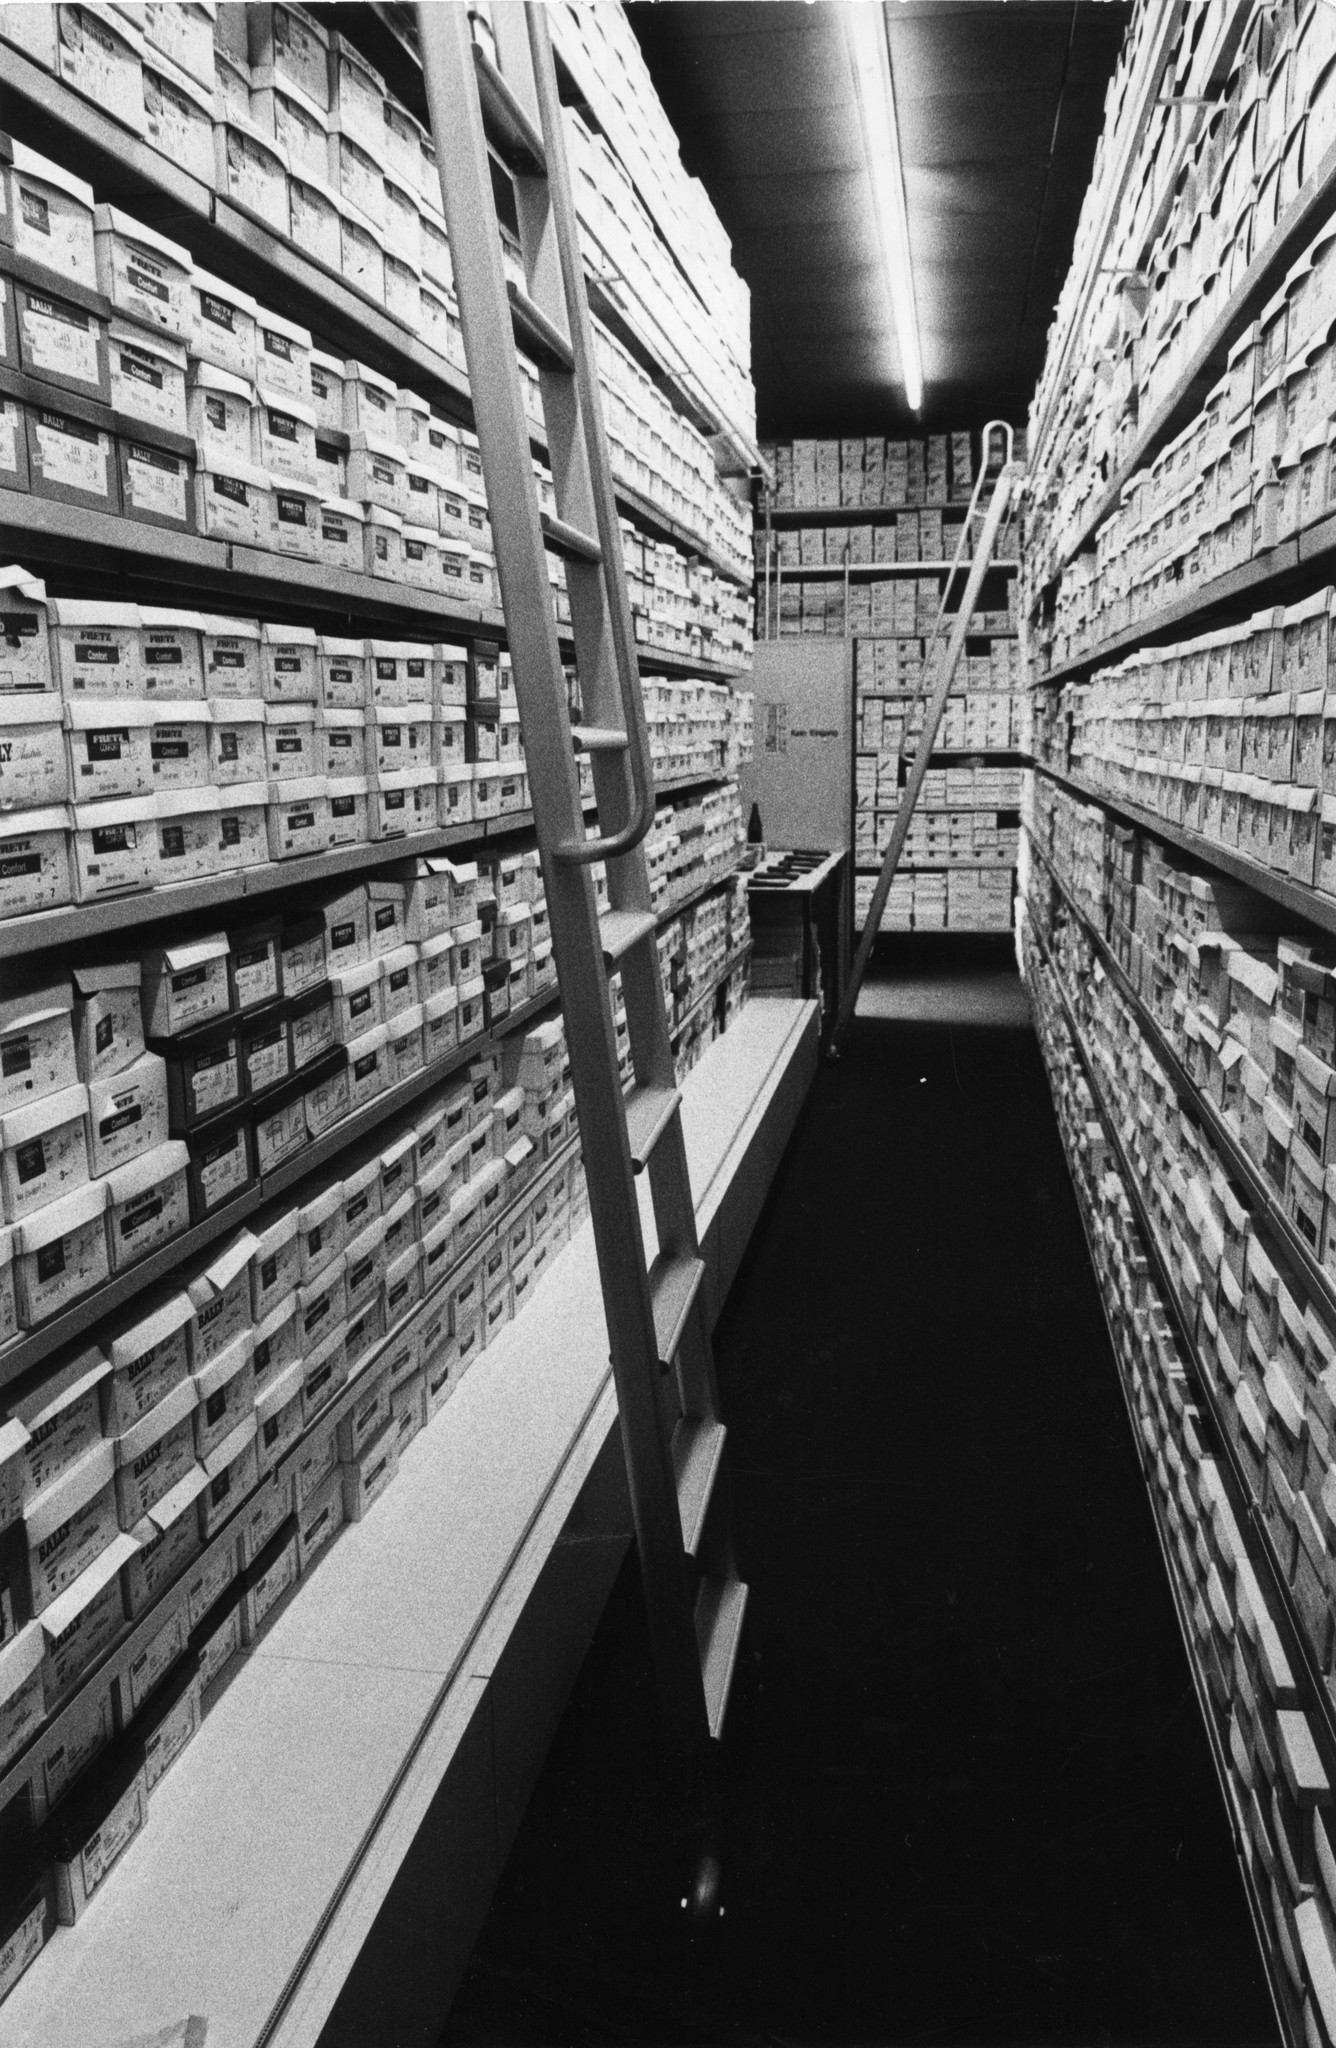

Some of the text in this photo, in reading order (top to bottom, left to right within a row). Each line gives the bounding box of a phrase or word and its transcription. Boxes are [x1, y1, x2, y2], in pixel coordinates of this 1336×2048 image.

[30, 297, 52, 316] BALLY
[42, 413, 65, 429] BALLY
[80, 631, 111, 641] FRETZ
[150, 634, 175, 643] FRETZ
[217, 640, 238, 648] FRETZ
[88, 650, 108, 661] Confort
[156, 651, 173, 661] Confort
[93, 733, 123, 744] FRETZ
[156, 729, 182, 738] FRETZ
[1, 863, 26, 875] Confort
[198, 1298, 224, 1329] BALLY
[128, 1349, 155, 1381] BALLY
[25, 1415, 59, 1455] BALLY
[134, 1441, 162, 1479] BALLY
[38, 1523, 70, 1564] BALLY
